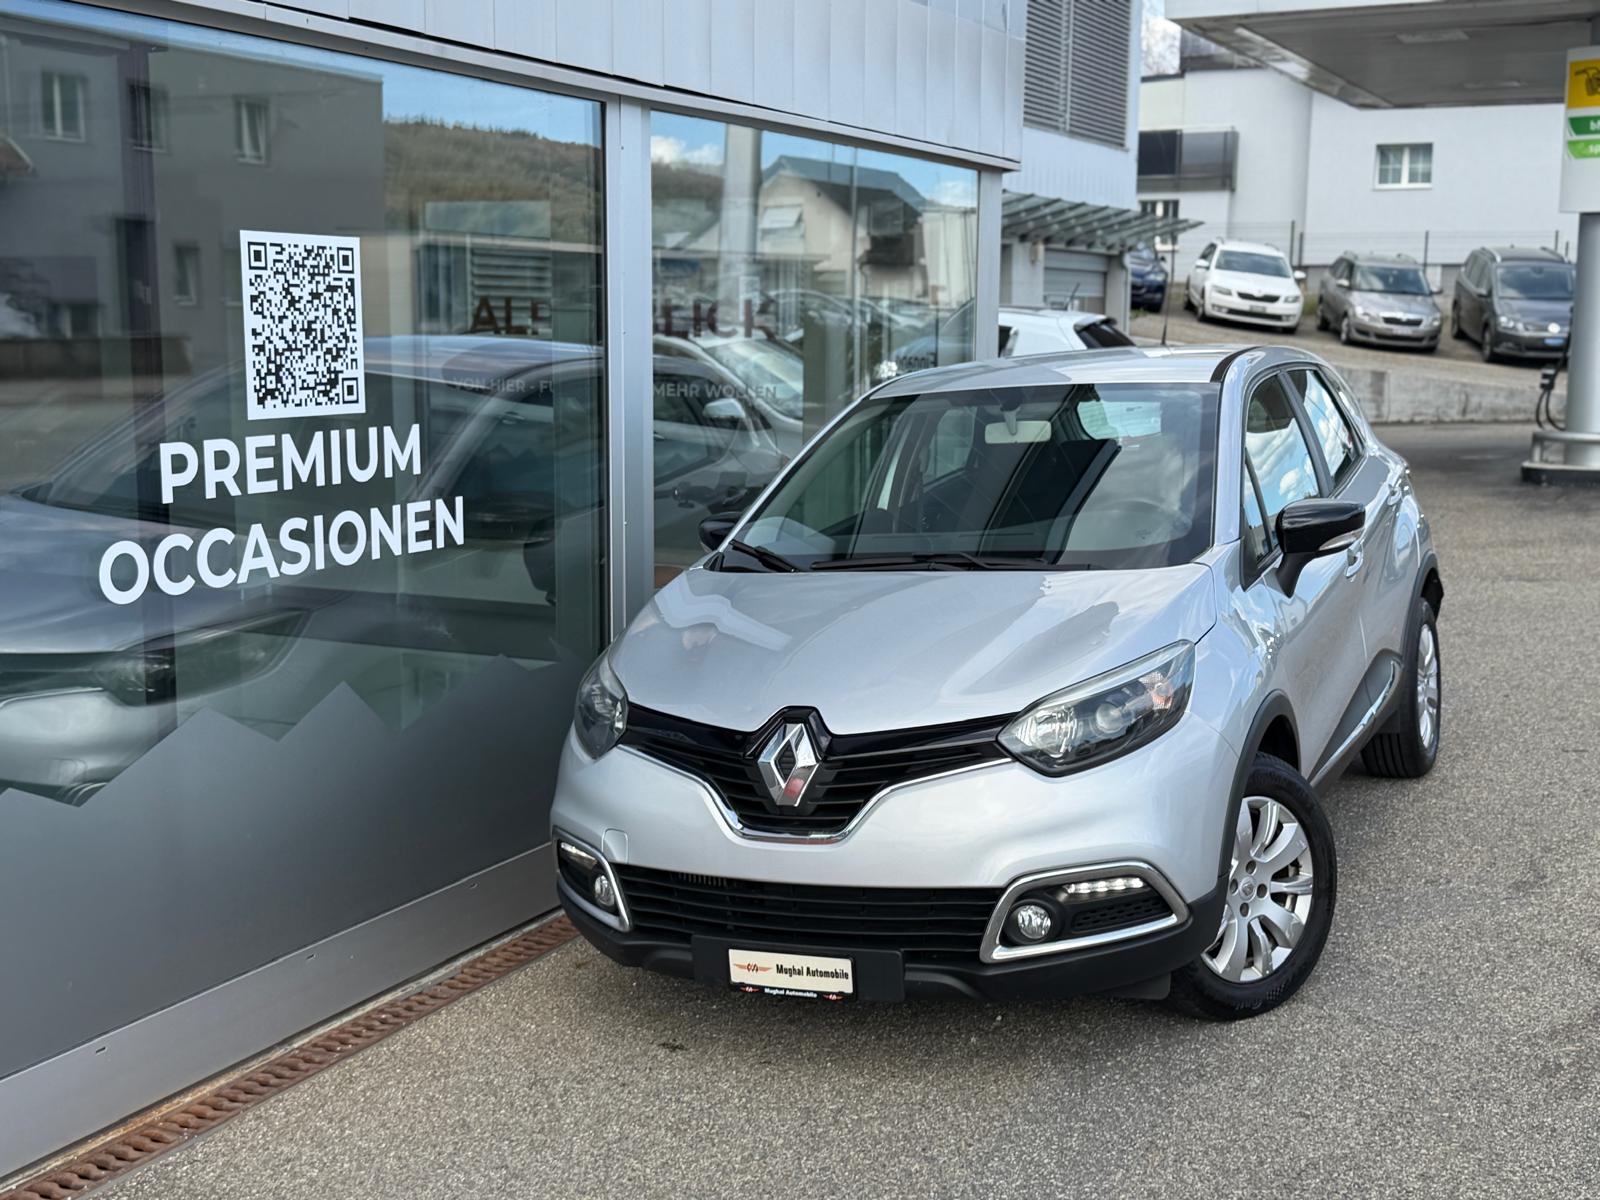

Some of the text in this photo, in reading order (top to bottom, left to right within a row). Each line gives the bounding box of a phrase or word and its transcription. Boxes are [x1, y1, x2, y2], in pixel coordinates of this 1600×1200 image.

[490, 377, 526, 393] HIER
[653, 382, 700, 398] MEHR
[160, 424, 421, 504] PREMIUM
[99, 496, 465, 605] OCCASIONEN
[776, 963, 804, 978] Mughal
[806, 966, 849, 980] Automobile
[764, 987, 785, 996] Mughal
[785, 988, 818, 998] Automobile
